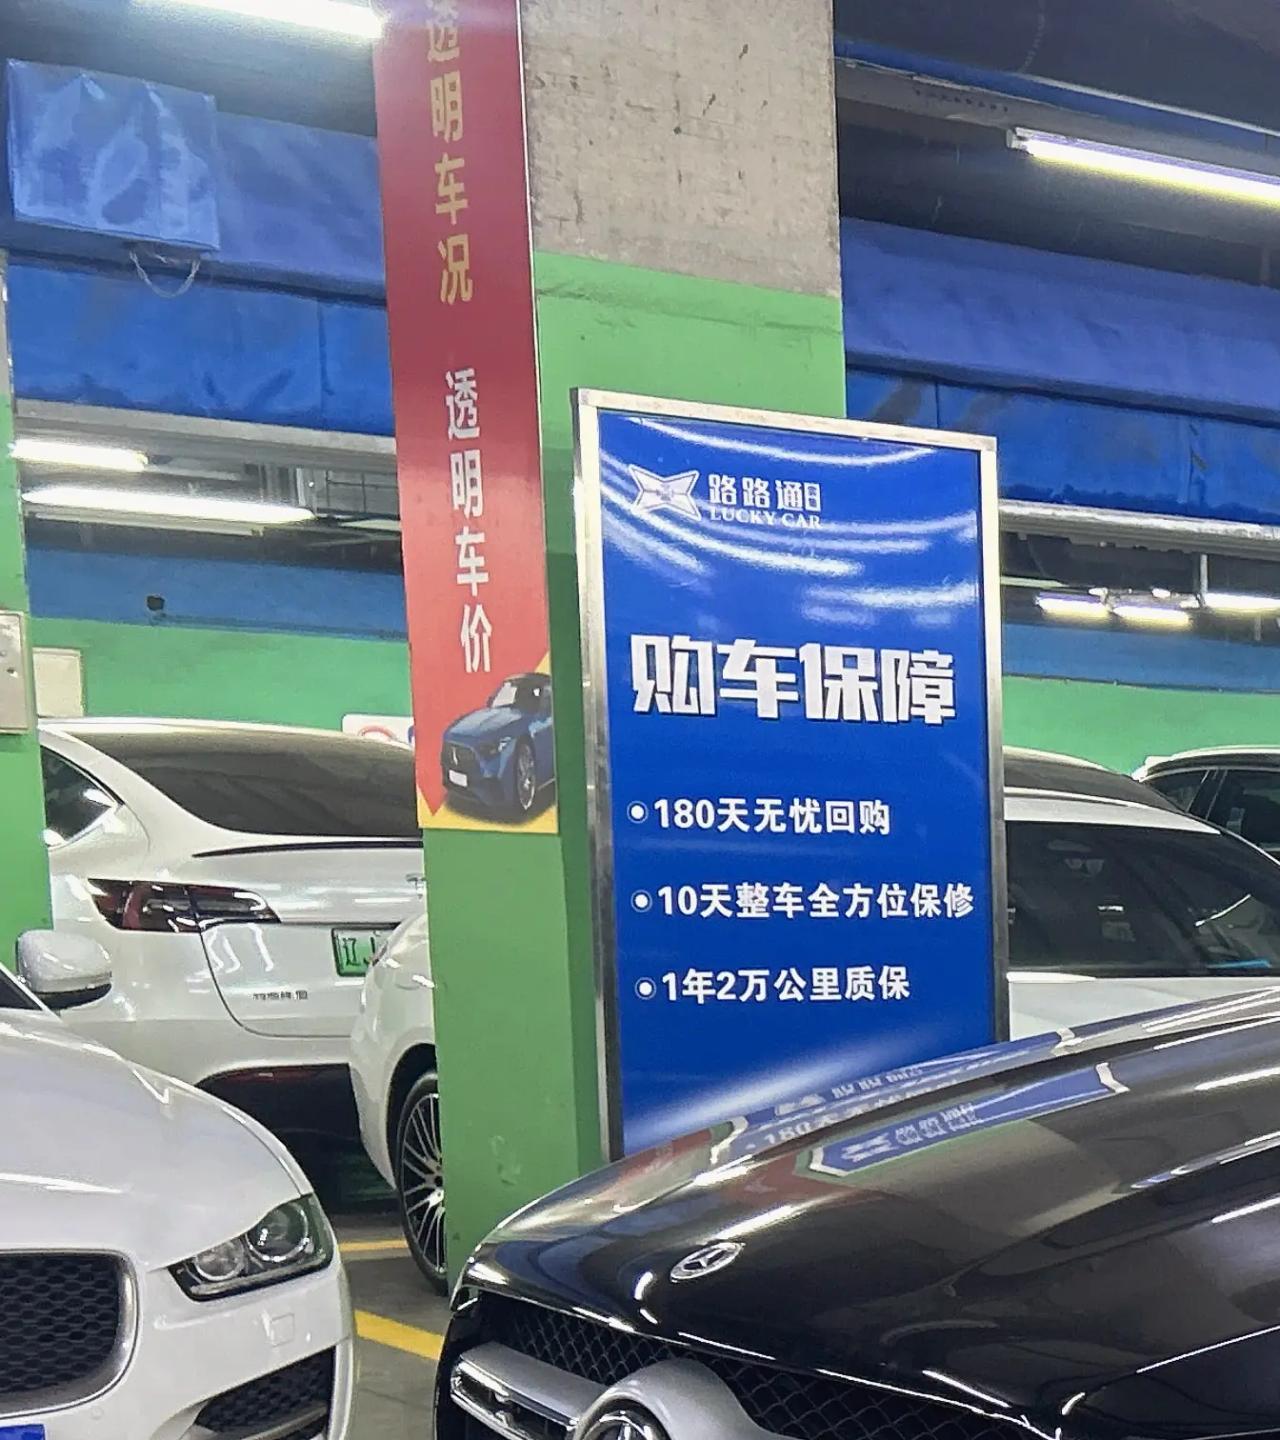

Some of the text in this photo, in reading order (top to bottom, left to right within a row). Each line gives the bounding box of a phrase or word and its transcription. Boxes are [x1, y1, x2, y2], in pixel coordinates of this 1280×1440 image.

[446, 369, 492, 673] 透明车价
[710, 509, 822, 528] LUCKY CAR
[631, 634, 956, 725] 购车保障
[654, 798, 891, 835] 180天无忧回购
[658, 882, 974, 919] 10天整车全方位保修
[662, 966, 910, 1005] 1年2万公里质保
